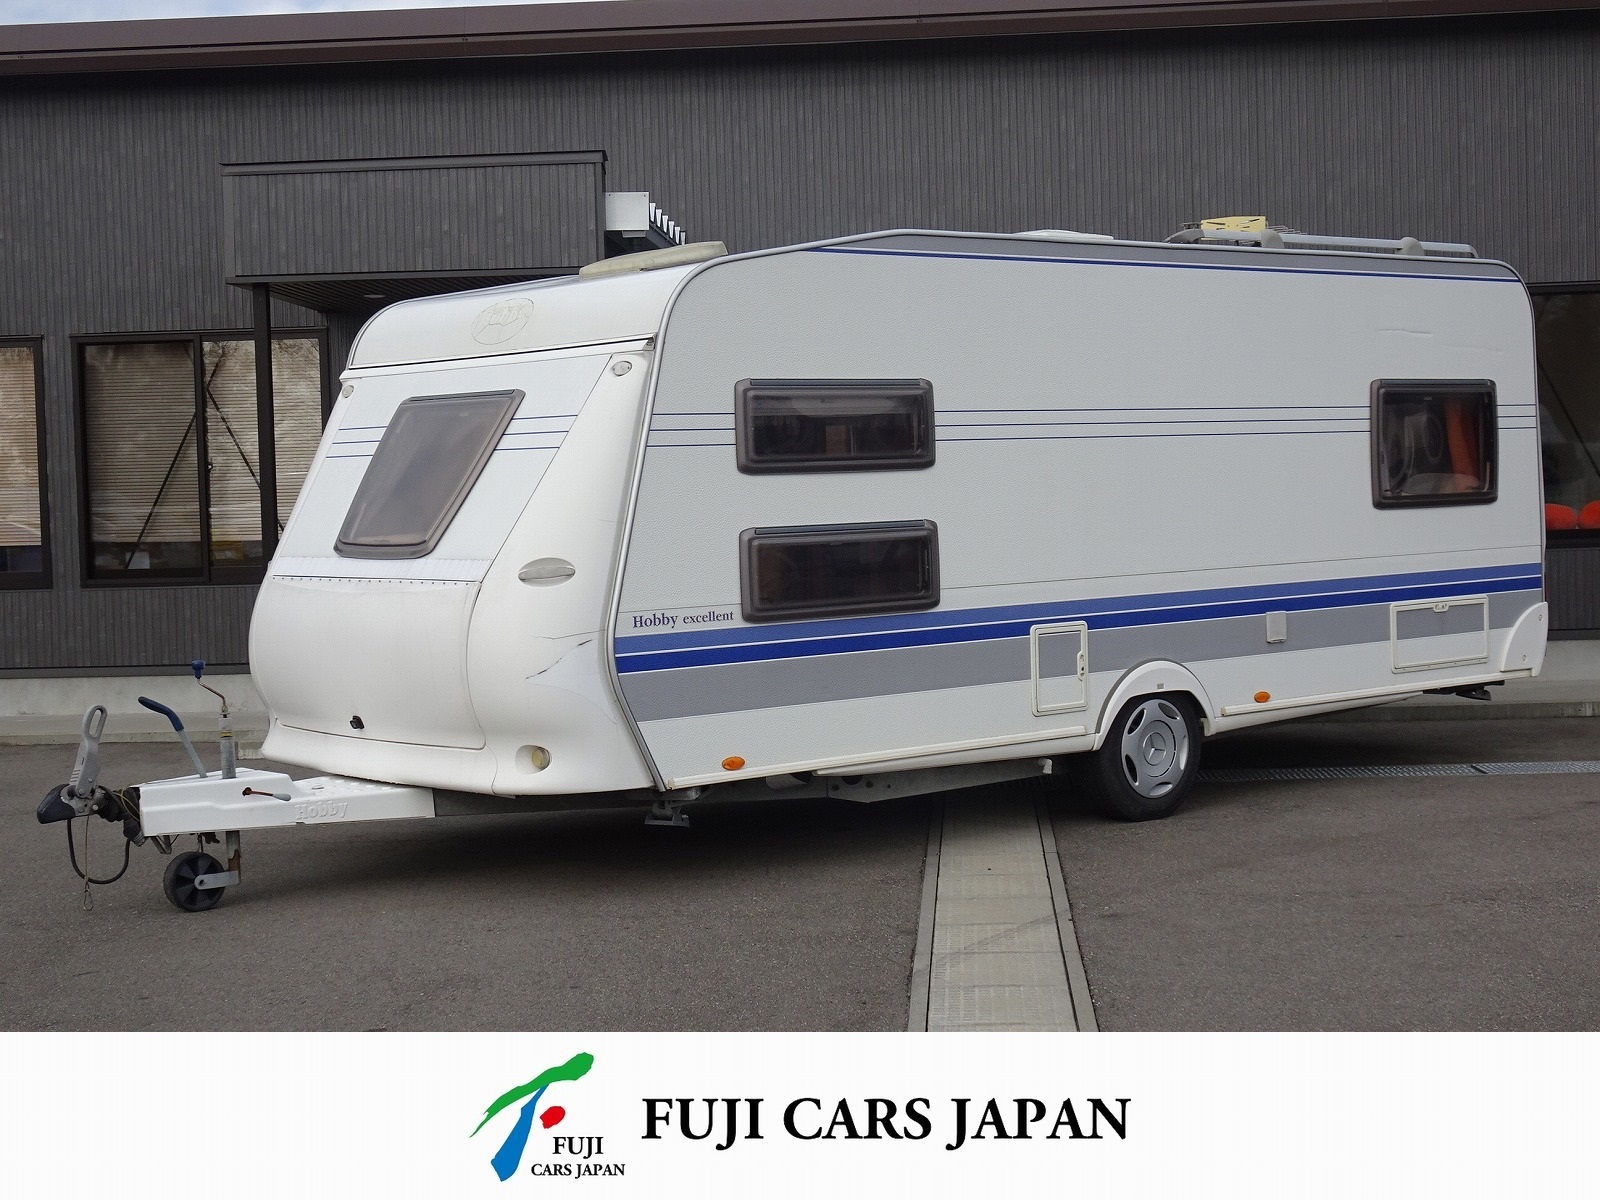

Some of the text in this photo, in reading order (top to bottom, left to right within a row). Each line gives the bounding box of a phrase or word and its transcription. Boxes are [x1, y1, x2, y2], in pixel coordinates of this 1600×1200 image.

[632, 610, 734, 629] Hobby excellent
[294, 801, 349, 820] Hobby
